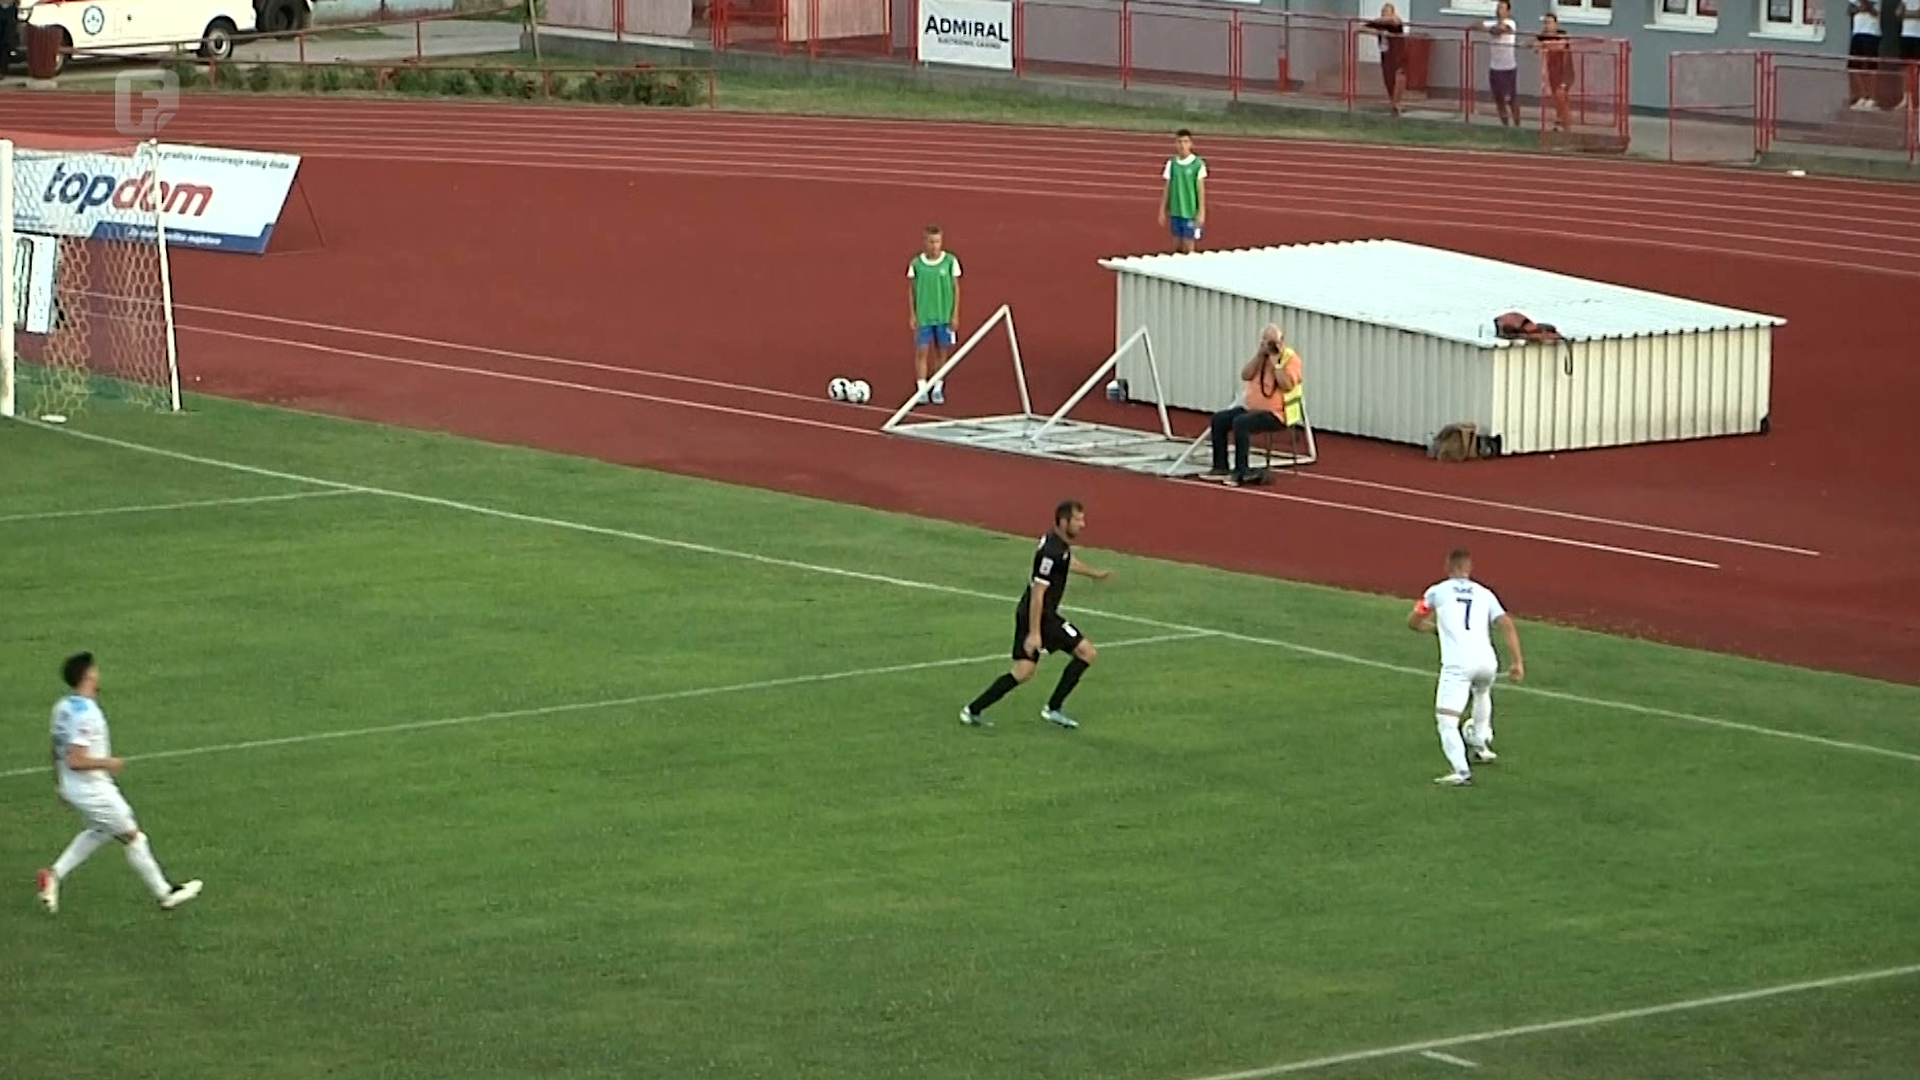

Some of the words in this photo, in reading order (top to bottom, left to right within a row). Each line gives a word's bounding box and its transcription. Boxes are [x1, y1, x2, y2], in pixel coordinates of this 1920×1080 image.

[924, 14, 1008, 42] ADMIRAL
[43, 162, 213, 216] topdom
[1456, 597, 1472, 630] 7
